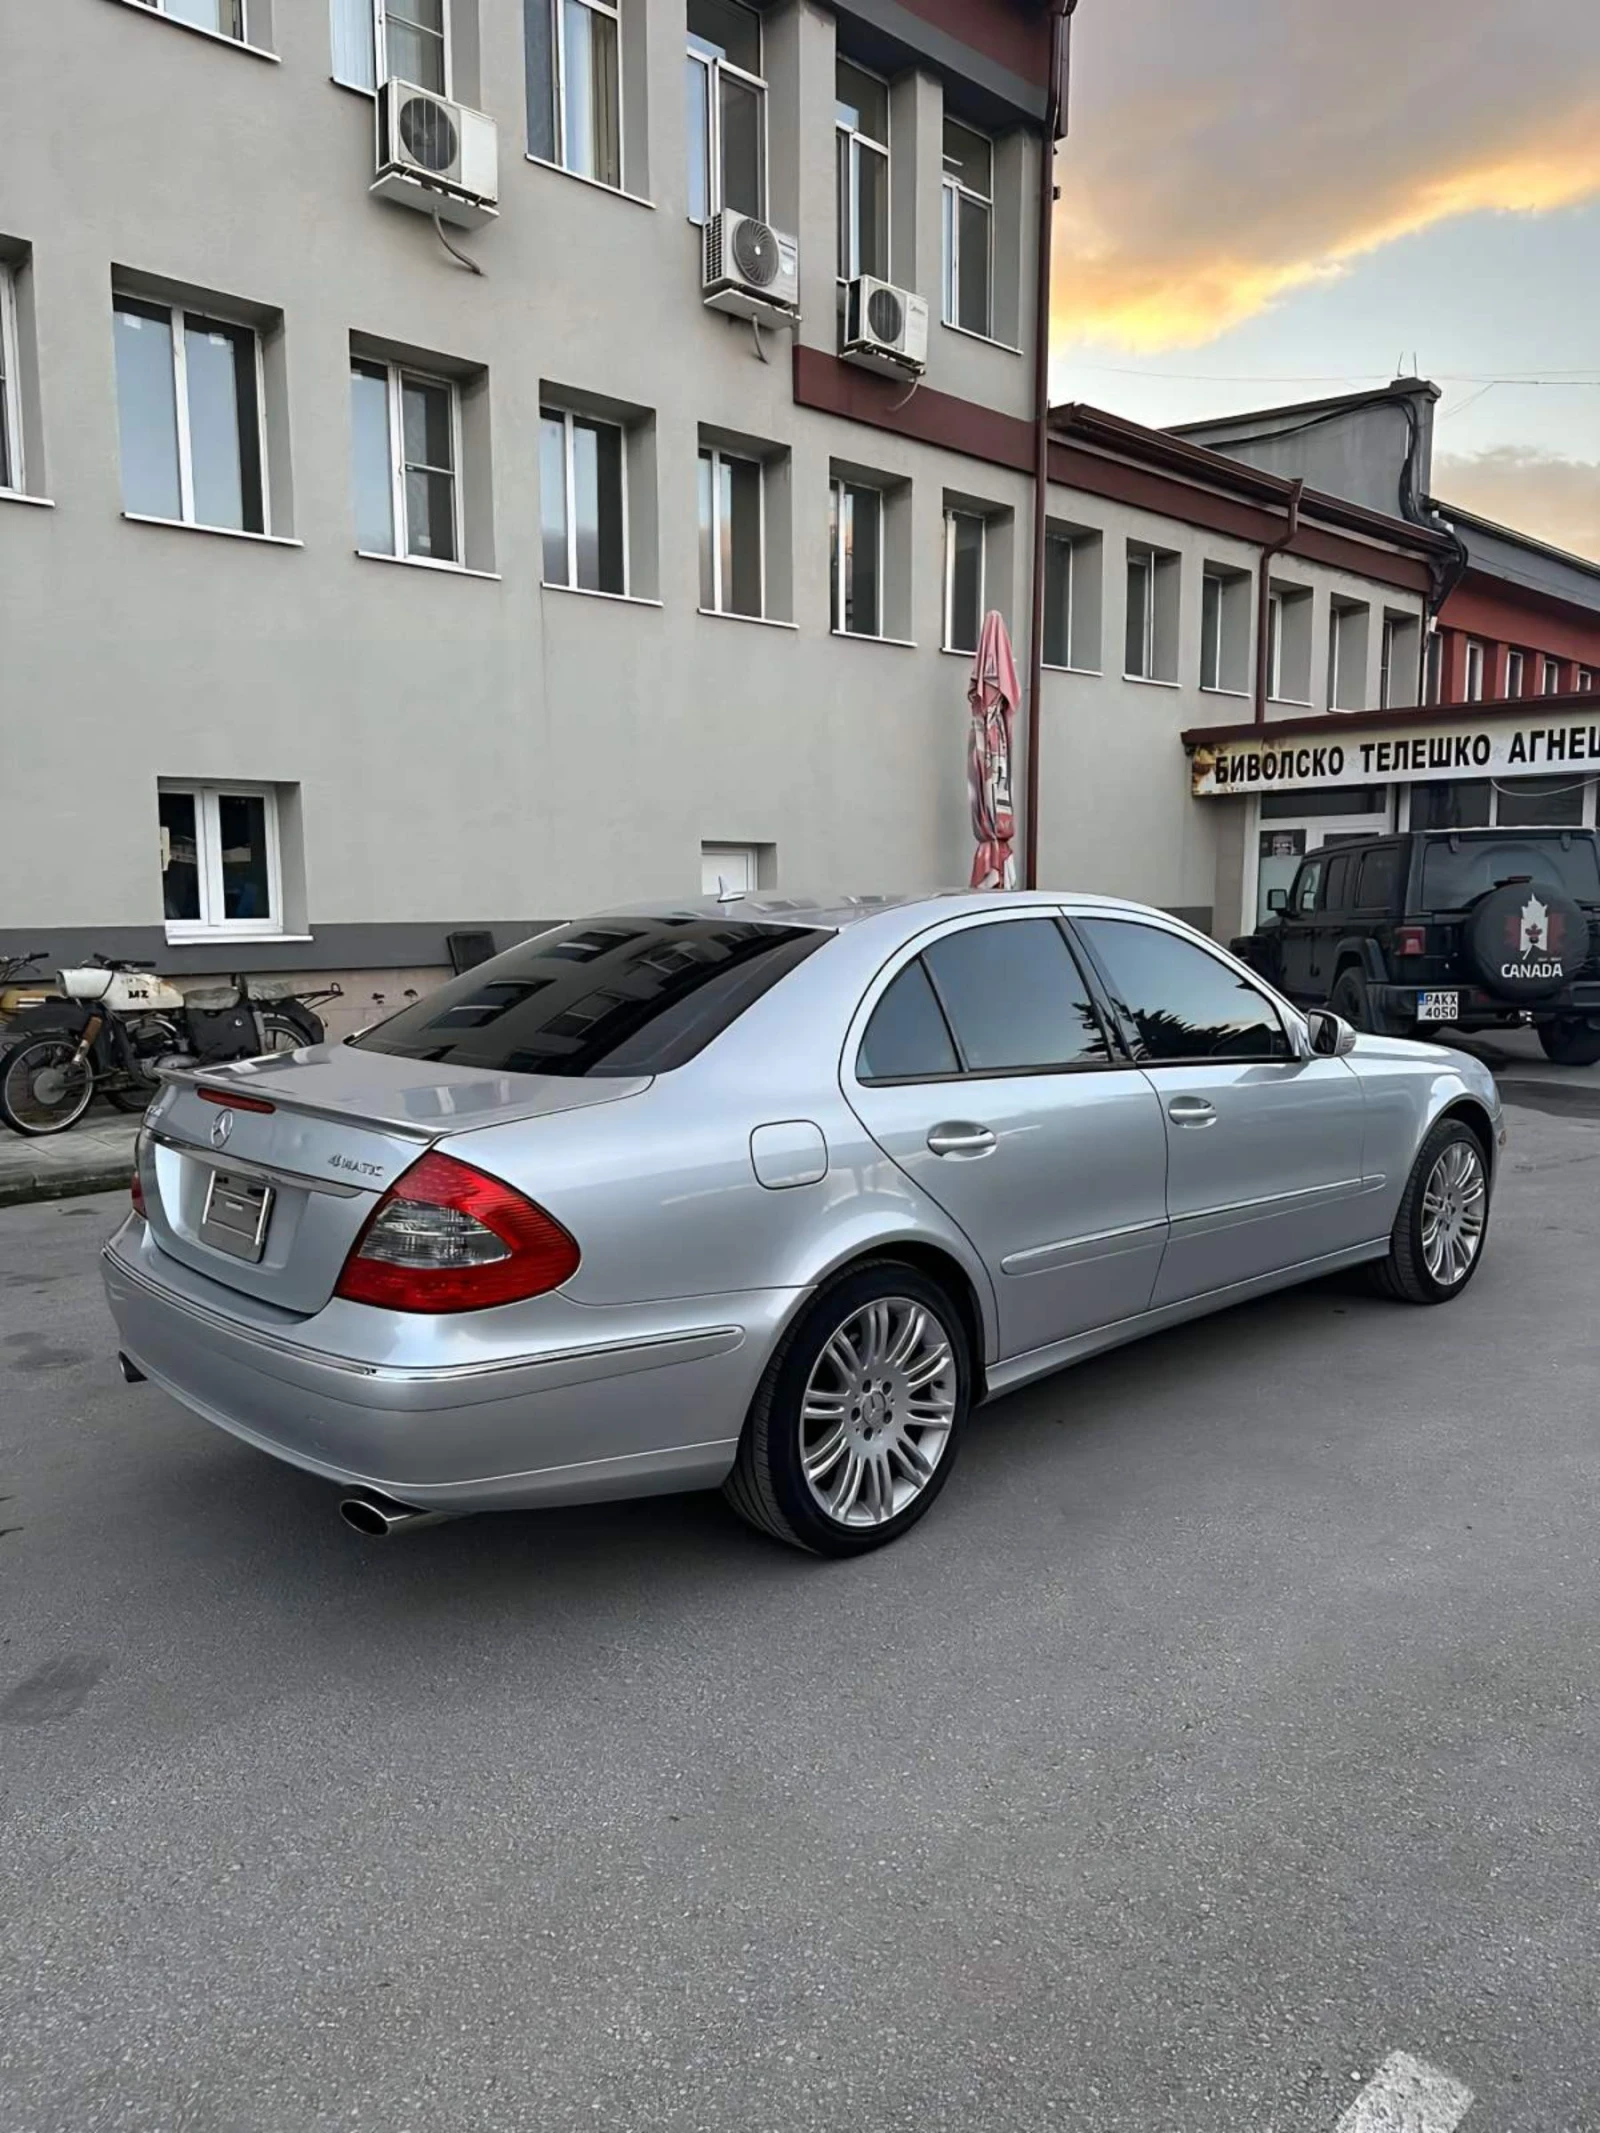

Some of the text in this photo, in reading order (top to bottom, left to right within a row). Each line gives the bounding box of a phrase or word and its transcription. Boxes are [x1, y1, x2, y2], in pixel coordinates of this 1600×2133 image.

[1215, 747, 1344, 784] БИВОЛСКО
[1359, 734, 1491, 773] ТЕЛЕШКО
[1501, 963, 1563, 977] CANADA
[1425, 1006, 1457, 1018] 4050
